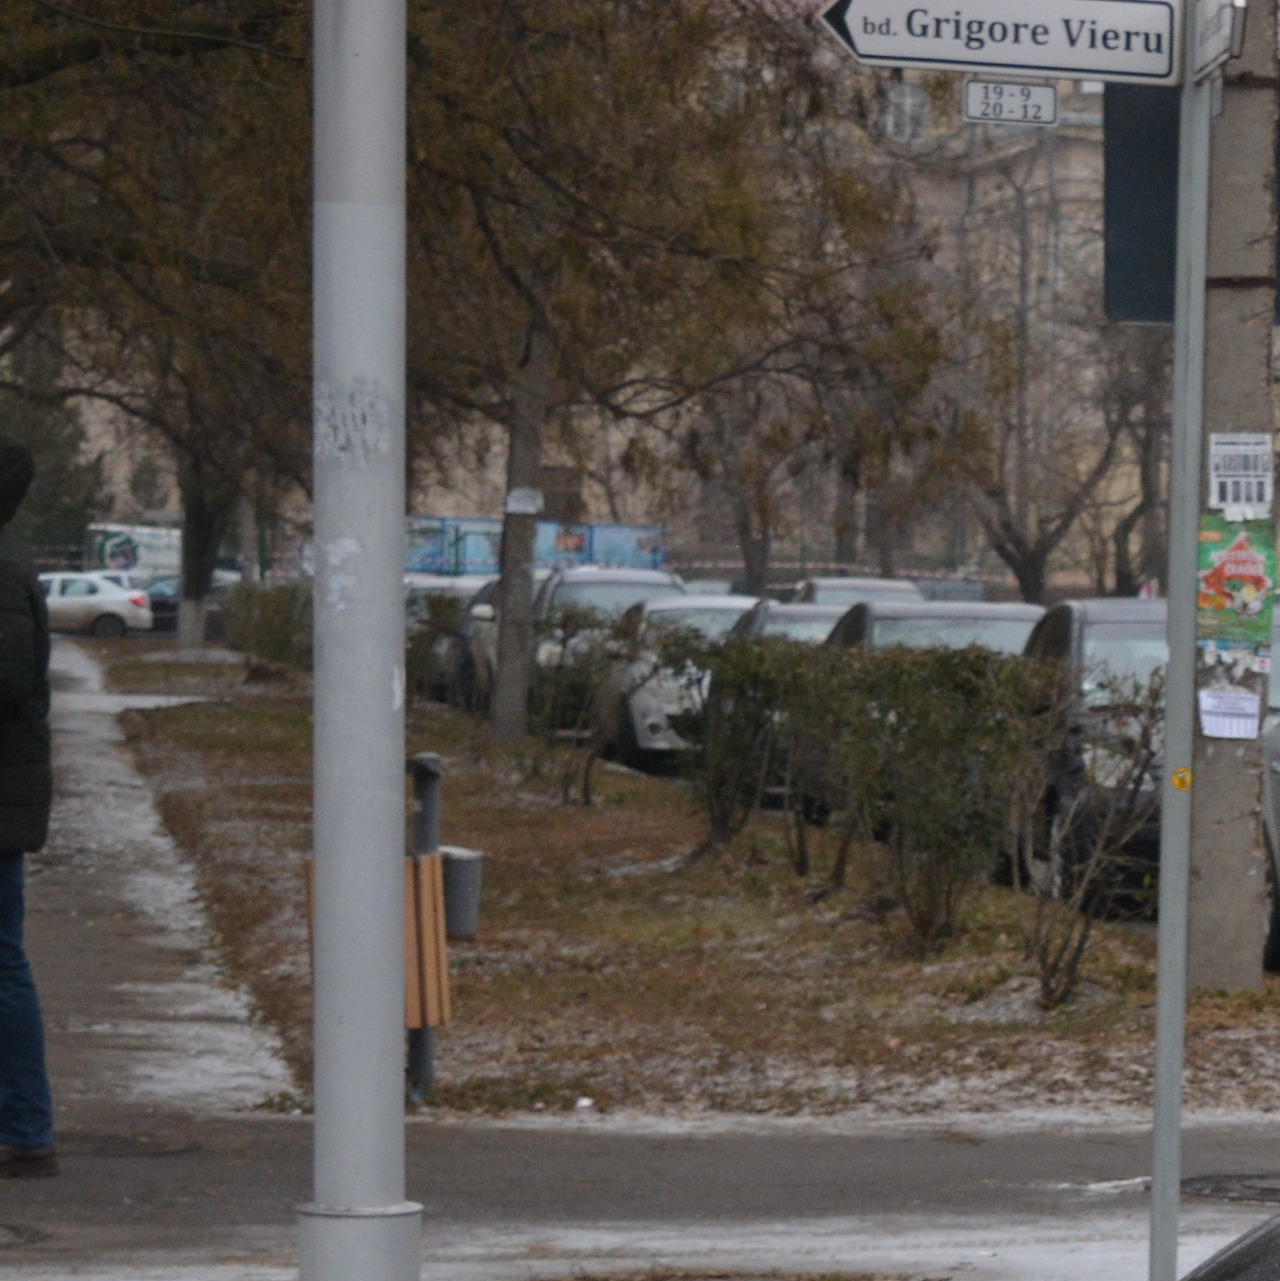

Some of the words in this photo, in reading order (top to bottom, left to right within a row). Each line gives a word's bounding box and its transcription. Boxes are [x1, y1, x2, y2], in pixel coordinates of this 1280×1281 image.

[863, 16, 897, 36] bd.
[906, 8, 1050, 50] Grigore
[1061, 18, 1164, 54] Vieru
[981, 84, 1004, 101] 19
[1019, 87, 1032, 102] 9
[979, 101, 1004, 117] 20
[1020, 103, 1043, 120] 12
